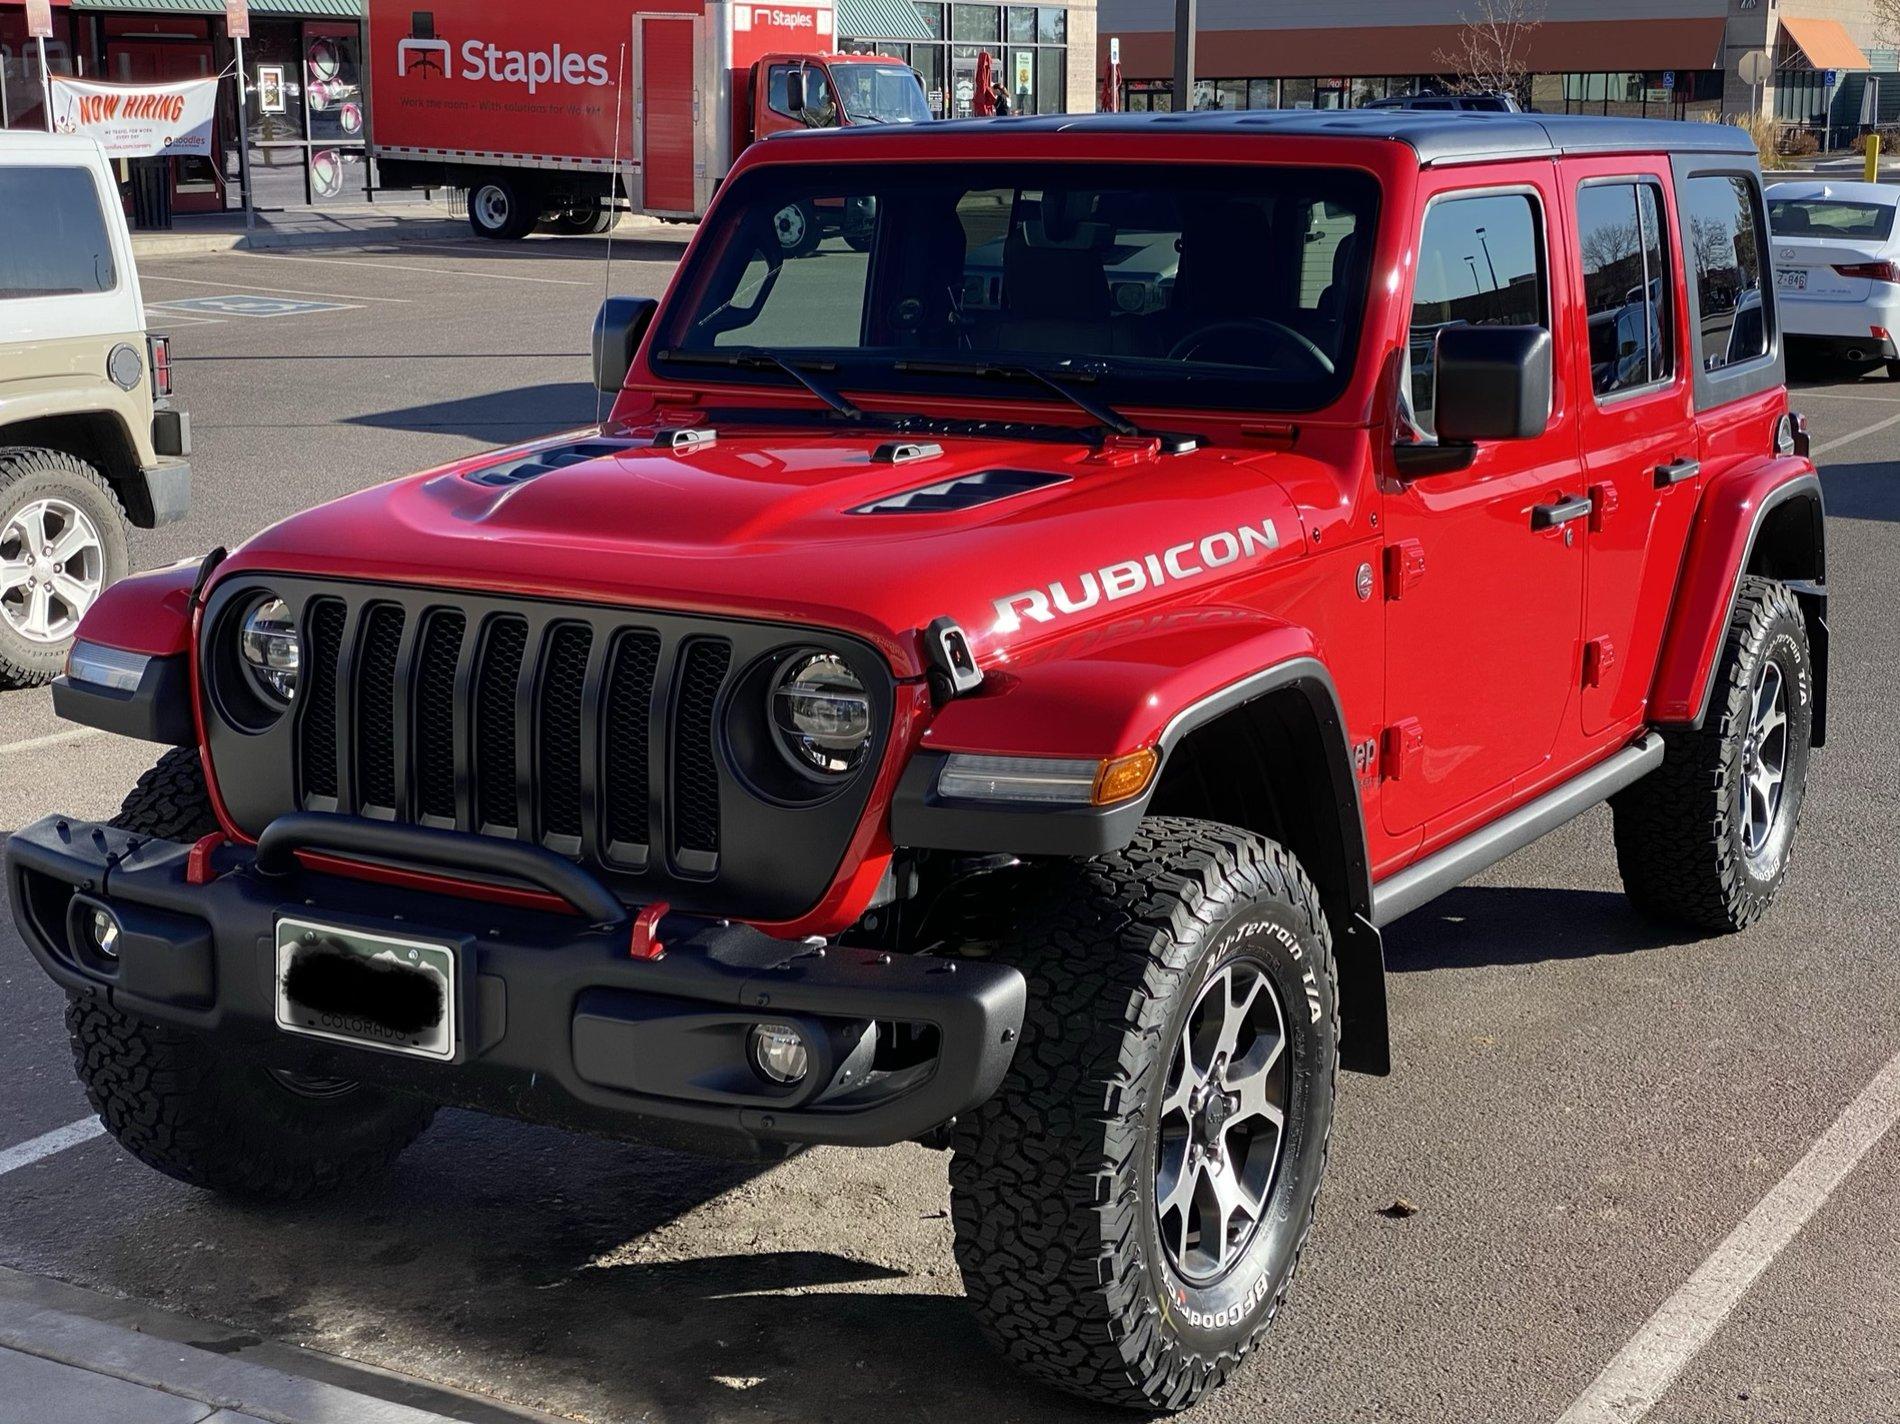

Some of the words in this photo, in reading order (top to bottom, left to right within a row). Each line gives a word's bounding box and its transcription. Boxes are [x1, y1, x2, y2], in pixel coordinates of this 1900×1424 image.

[772, 9, 813, 30] Staples
[461, 39, 609, 95] Staples
[79, 94, 119, 125] NOW
[122, 93, 186, 124] HIRING
[991, 518, 1281, 634] RUBICON
[1302, 965, 1322, 1025] T/A
[321, 1014, 406, 1040] COLORADO
